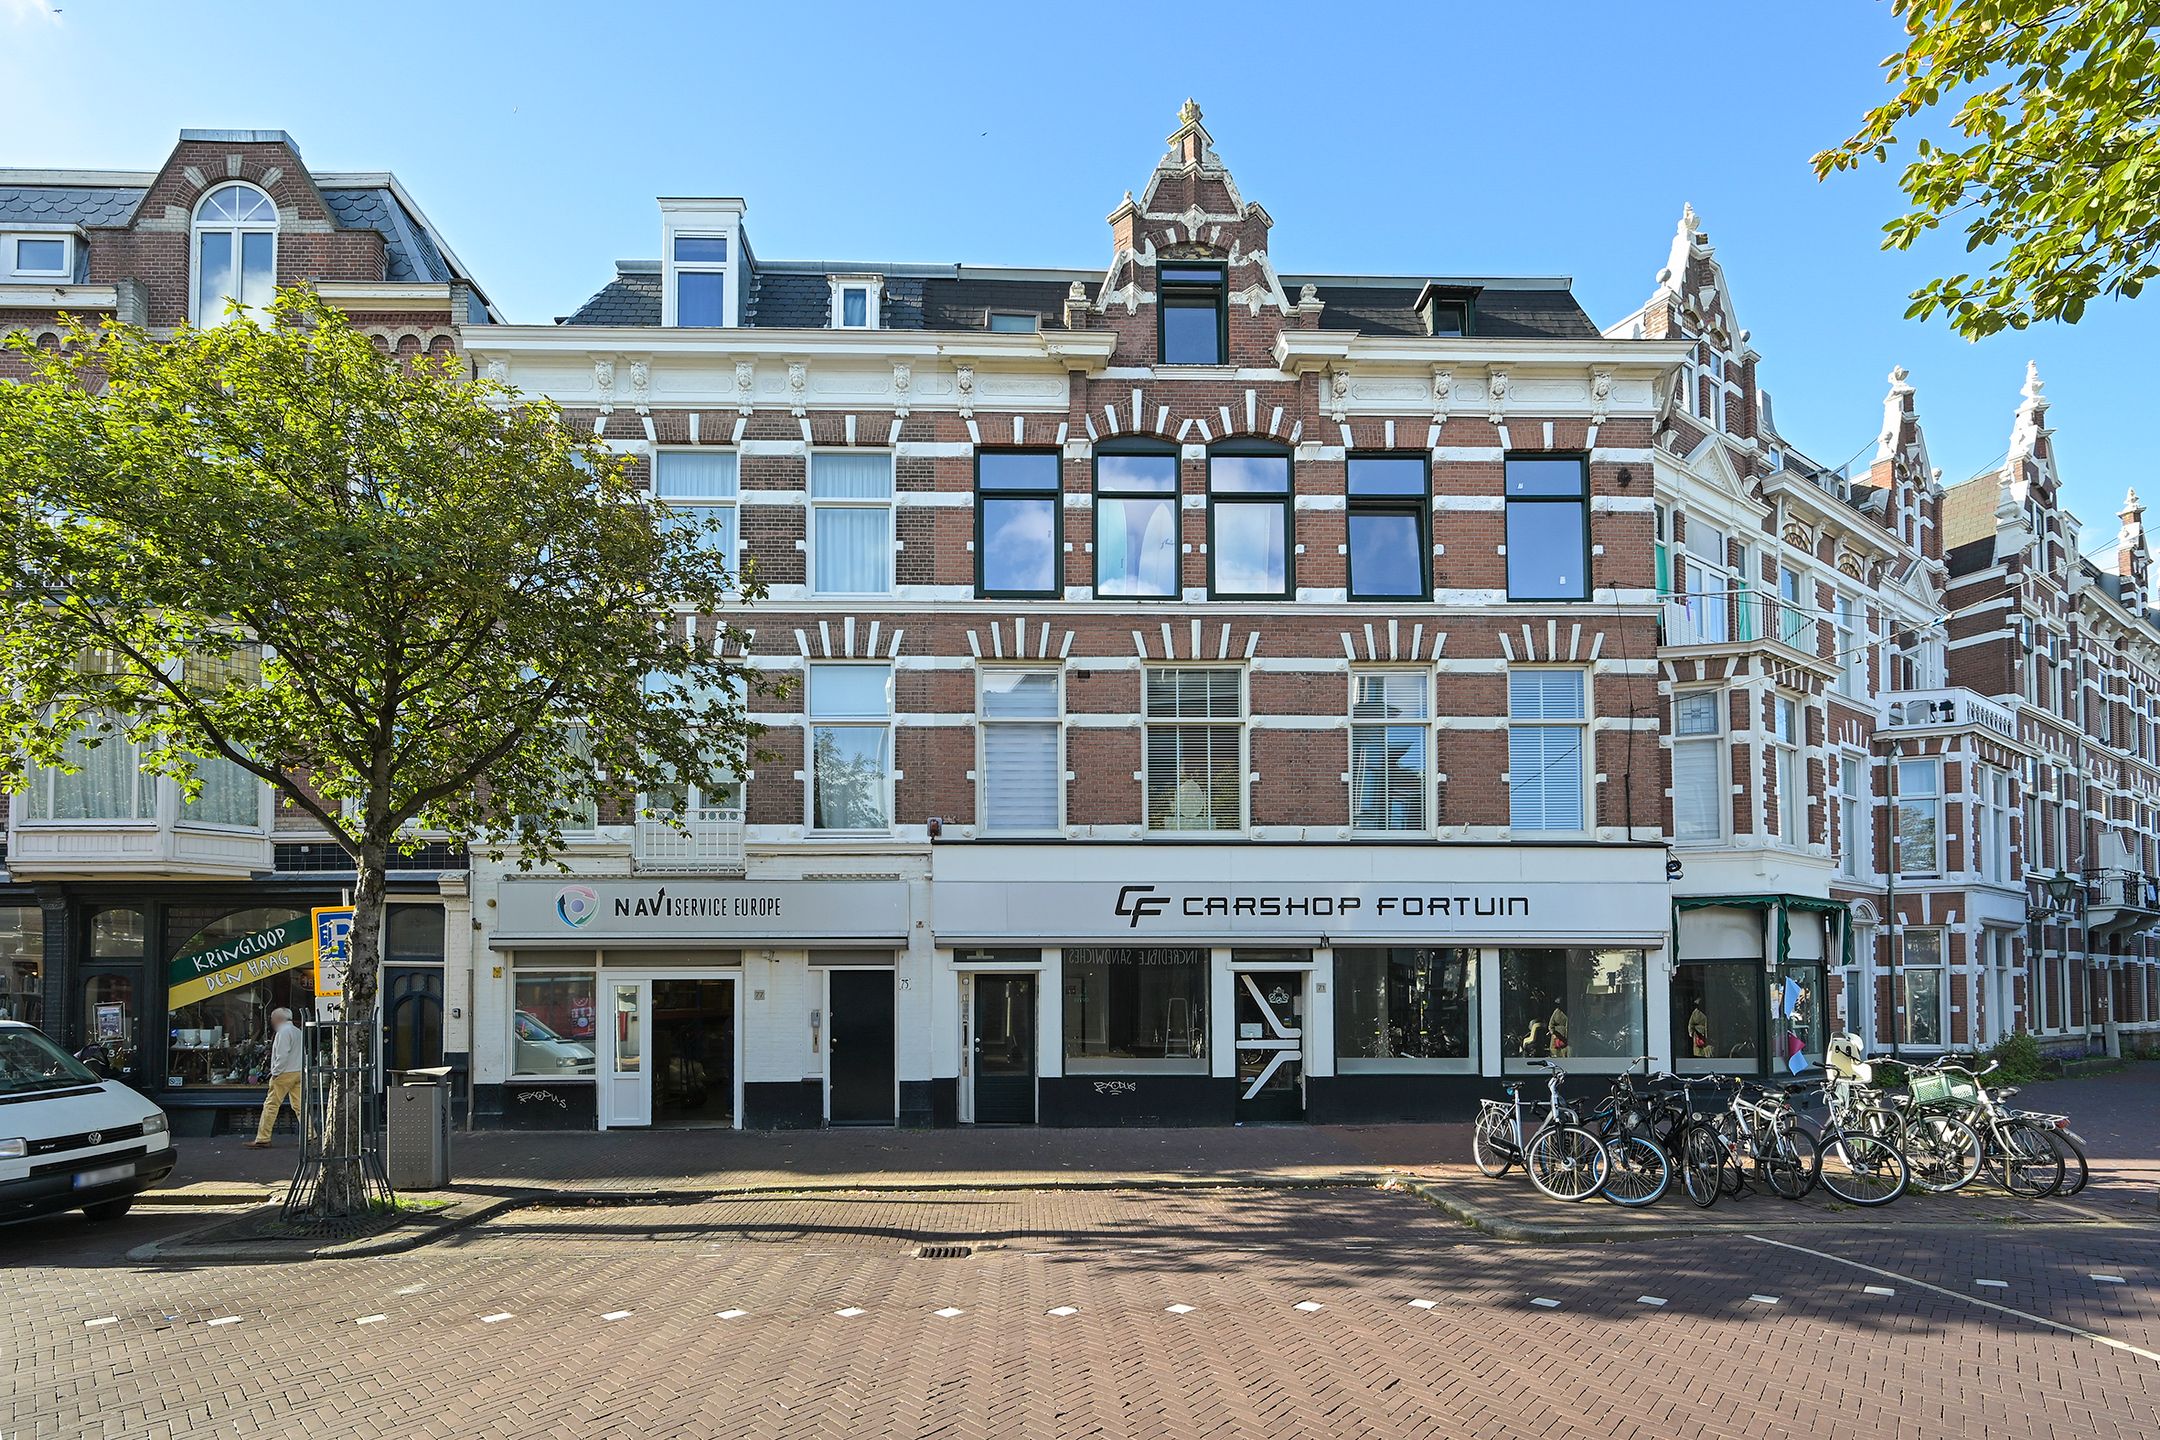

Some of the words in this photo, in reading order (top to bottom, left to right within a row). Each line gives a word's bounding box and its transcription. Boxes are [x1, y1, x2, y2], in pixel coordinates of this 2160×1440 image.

[734, 898, 782, 917] EUROPE
[1182, 896, 1361, 916] CARSHOP
[1376, 896, 1530, 916] FORTUIN
[204, 968, 243, 992] DEN
[246, 949, 290, 977] HAAG
